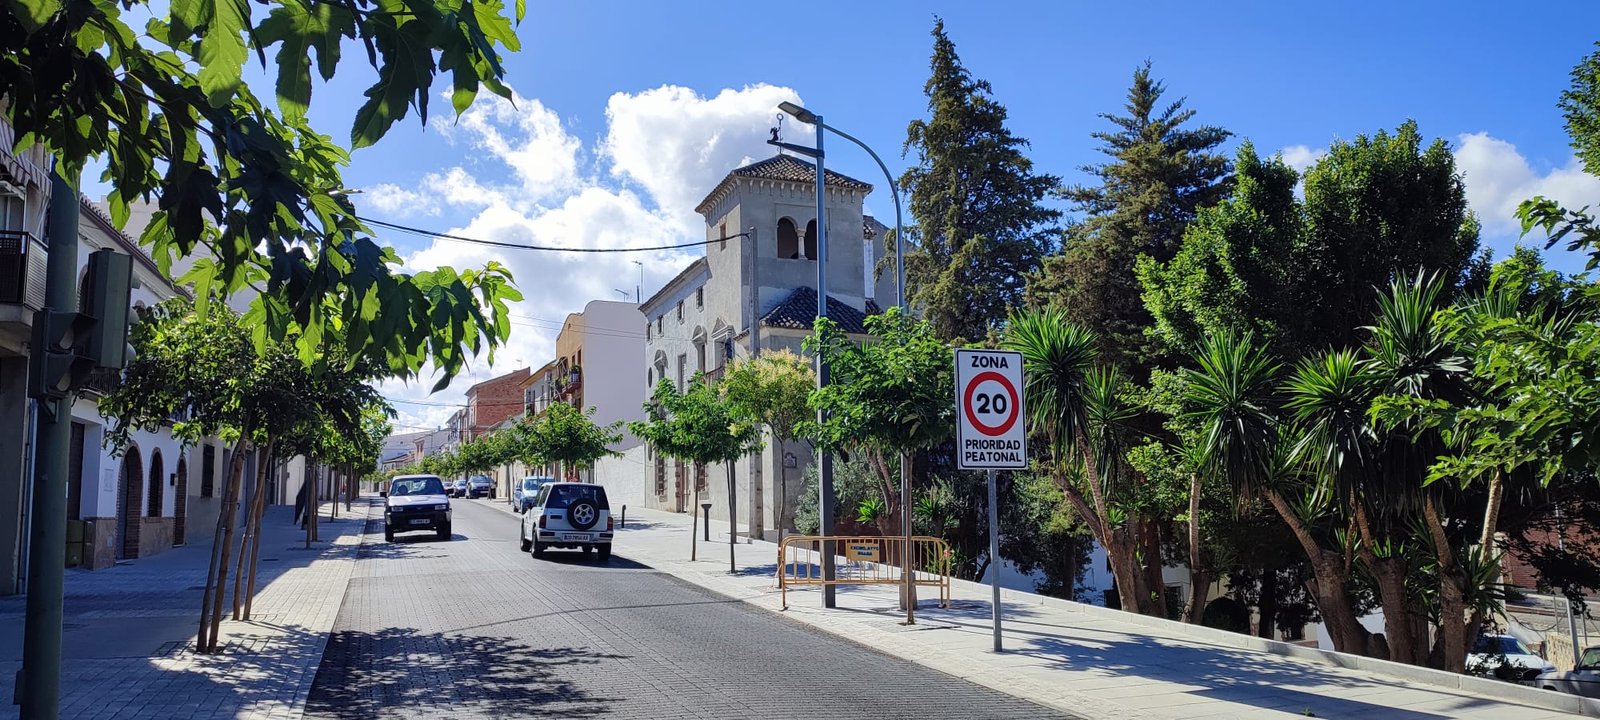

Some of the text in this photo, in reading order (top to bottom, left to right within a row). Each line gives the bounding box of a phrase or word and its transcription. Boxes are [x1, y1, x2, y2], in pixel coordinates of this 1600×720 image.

[971, 355, 1009, 369] ZONA
[976, 393, 1007, 415] 20
[965, 439, 1021, 450] PRIORIDAD
[965, 451, 1022, 462] PEATONAL
